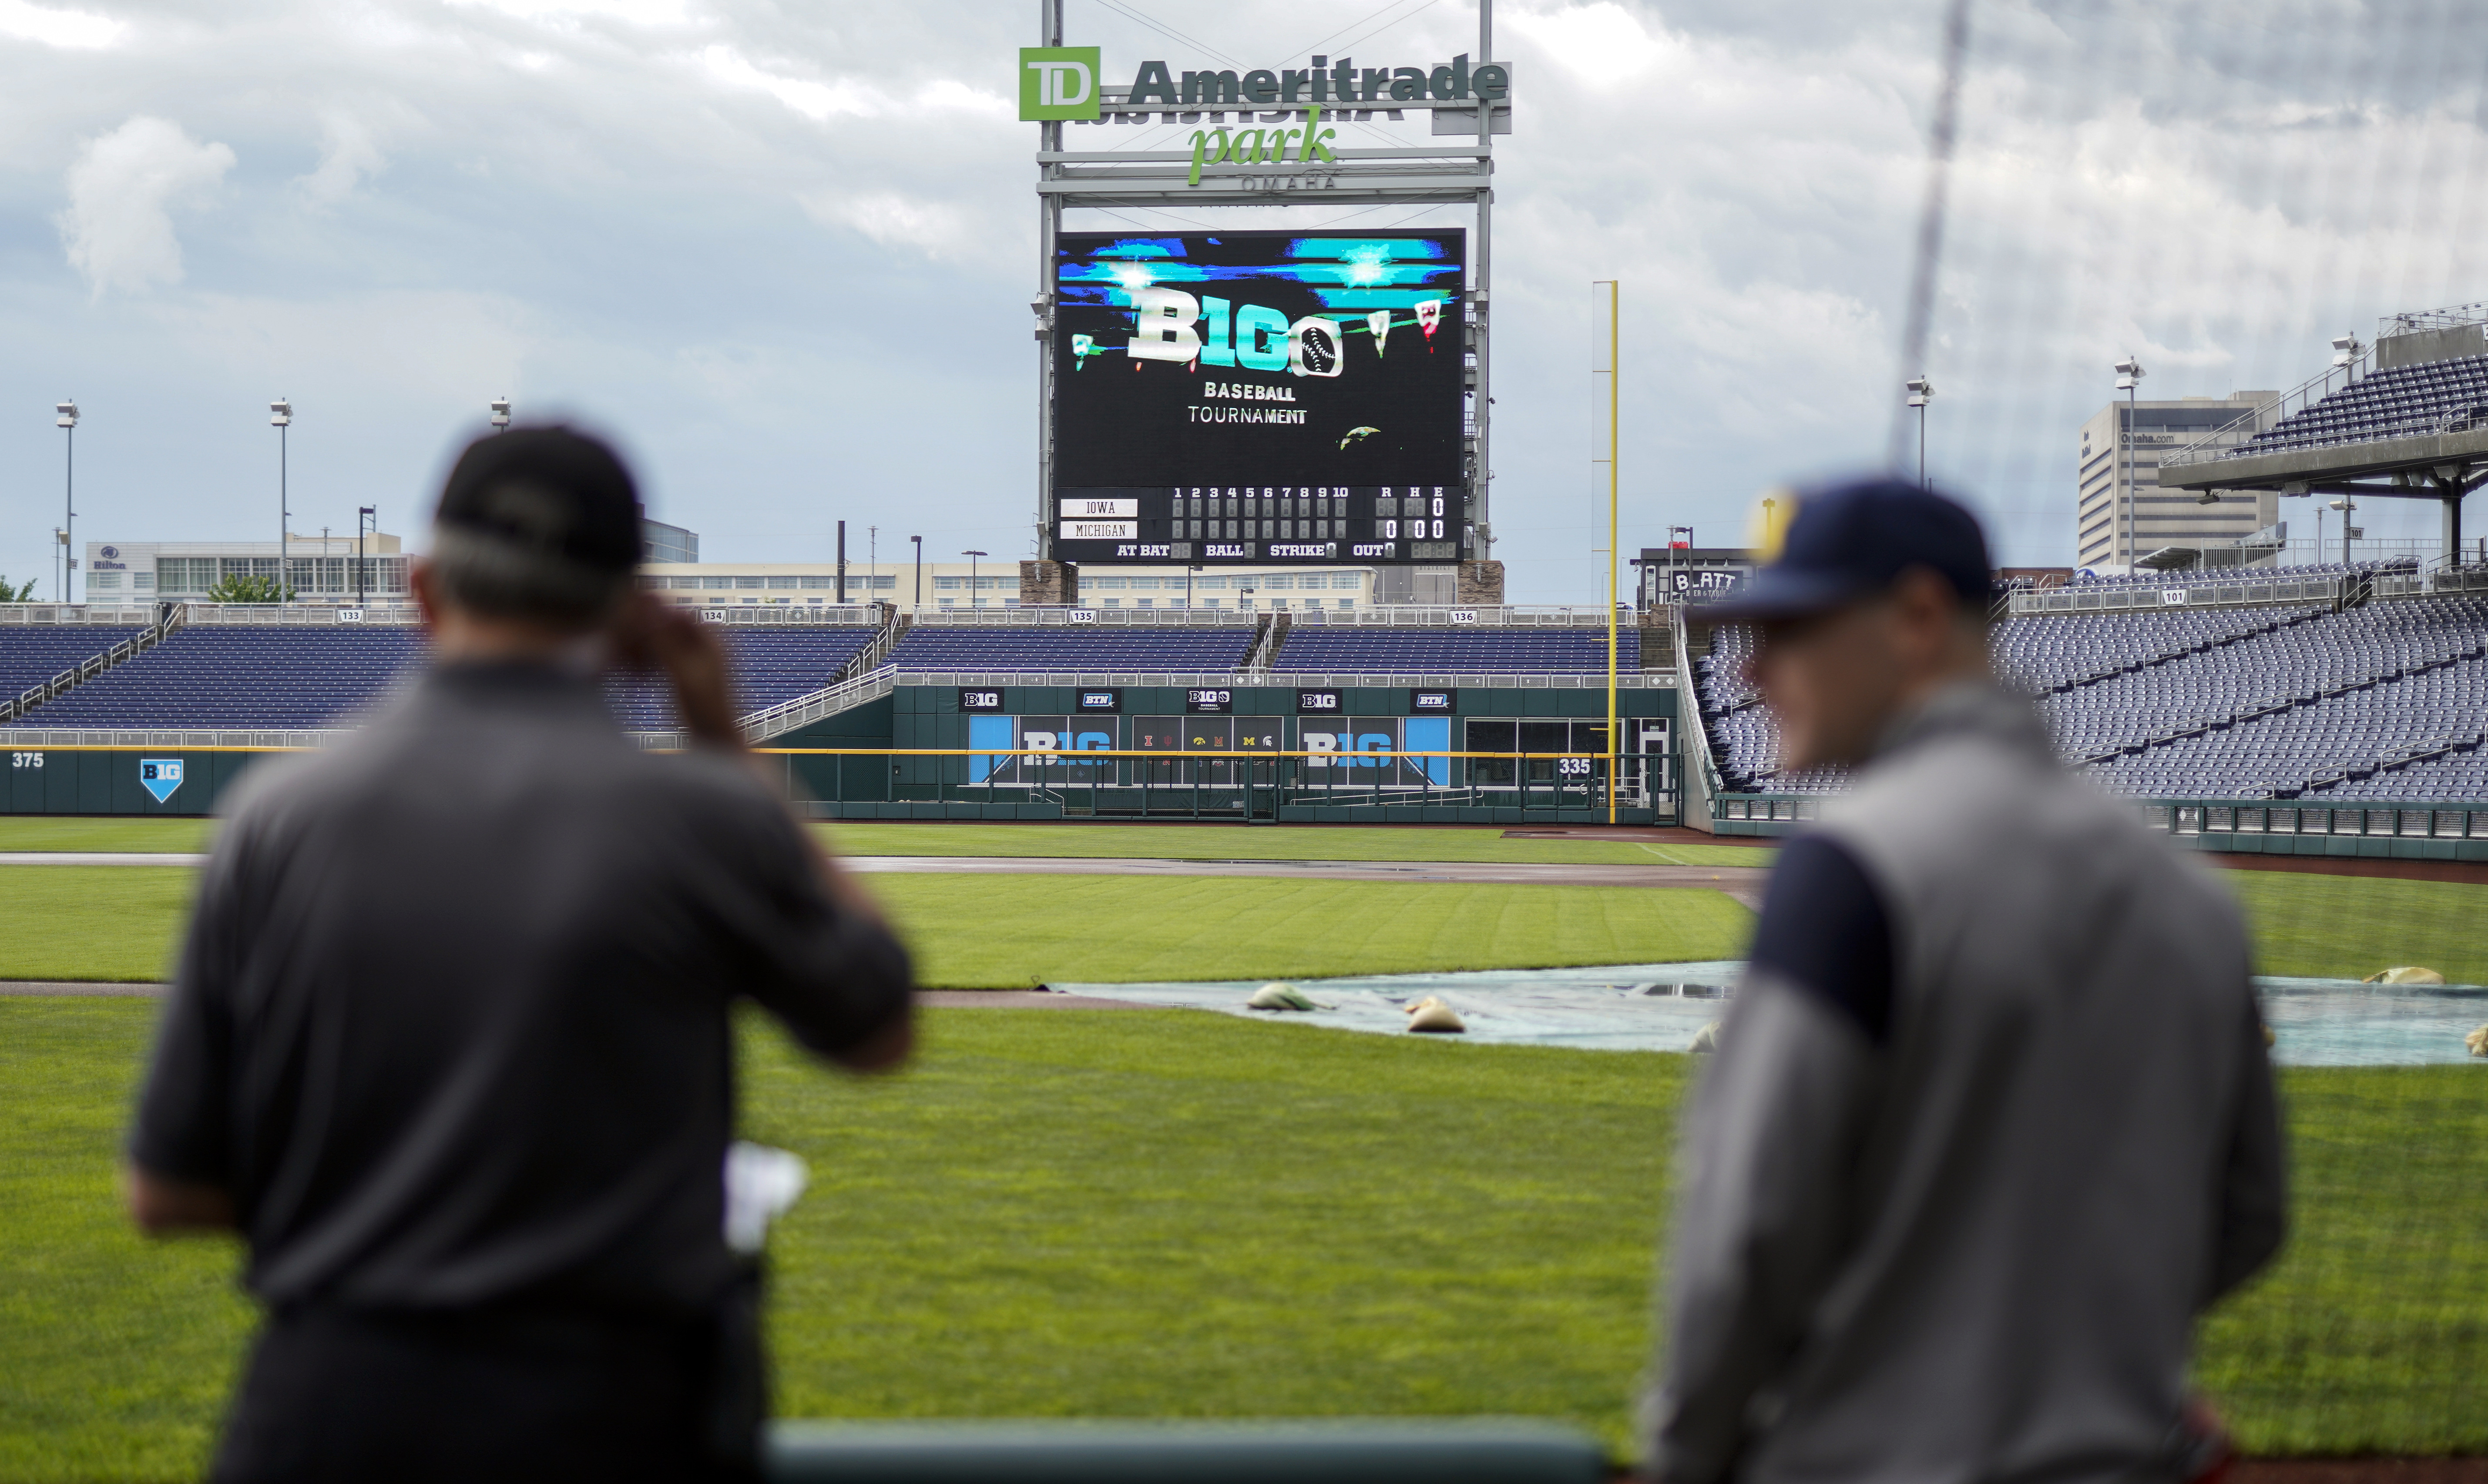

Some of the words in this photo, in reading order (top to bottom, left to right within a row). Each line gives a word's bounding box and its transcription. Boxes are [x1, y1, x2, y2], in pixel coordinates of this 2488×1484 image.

[1027, 62, 1091, 106] TD
[1128, 53, 1509, 105] Ameritrade
[1188, 105, 1336, 185] park
[1242, 175, 1336, 191] OMAHA
[1204, 382, 1296, 401] BASEBALL
[1188, 406, 1307, 424] TOURNAMENT
[1175, 487, 1181, 497] 1
[1192, 487, 1200, 497] 2
[1209, 487, 1219, 497] 3
[1227, 487, 1236, 497] 4
[1246, 487, 1254, 497] 5
[1264, 487, 1273, 497] 6
[1283, 487, 1291, 497] 7
[1300, 487, 1309, 497] 8
[1318, 487, 1327, 497] 9
[1333, 487, 1348, 497] 10
[1381, 487, 1391, 497] R
[1410, 487, 1420, 497] H
[1434, 487, 1443, 497] E
[1087, 502, 1115, 514] IOWA
[1433, 498, 1443, 517] 0
[1076, 525, 1125, 536] MICHIGAN
[1387, 520, 1397, 538] 0
[1415, 520, 1425, 538] 0
[1433, 520, 1443, 538] 0
[1117, 545, 1137, 556] AT
[1140, 545, 1169, 556] BAT
[1206, 545, 1243, 556] BALL
[1270, 545, 1325, 556] STRIKE
[1353, 545, 1383, 556] OUT
[94, 561, 126, 569] Hilton
[2166, 592, 2182, 601] 101
[1085, 695, 1109, 705] BTN
[1419, 696, 1444, 705] BTN
[12, 752, 44, 767] 375
[1559, 758, 1591, 774] 335
